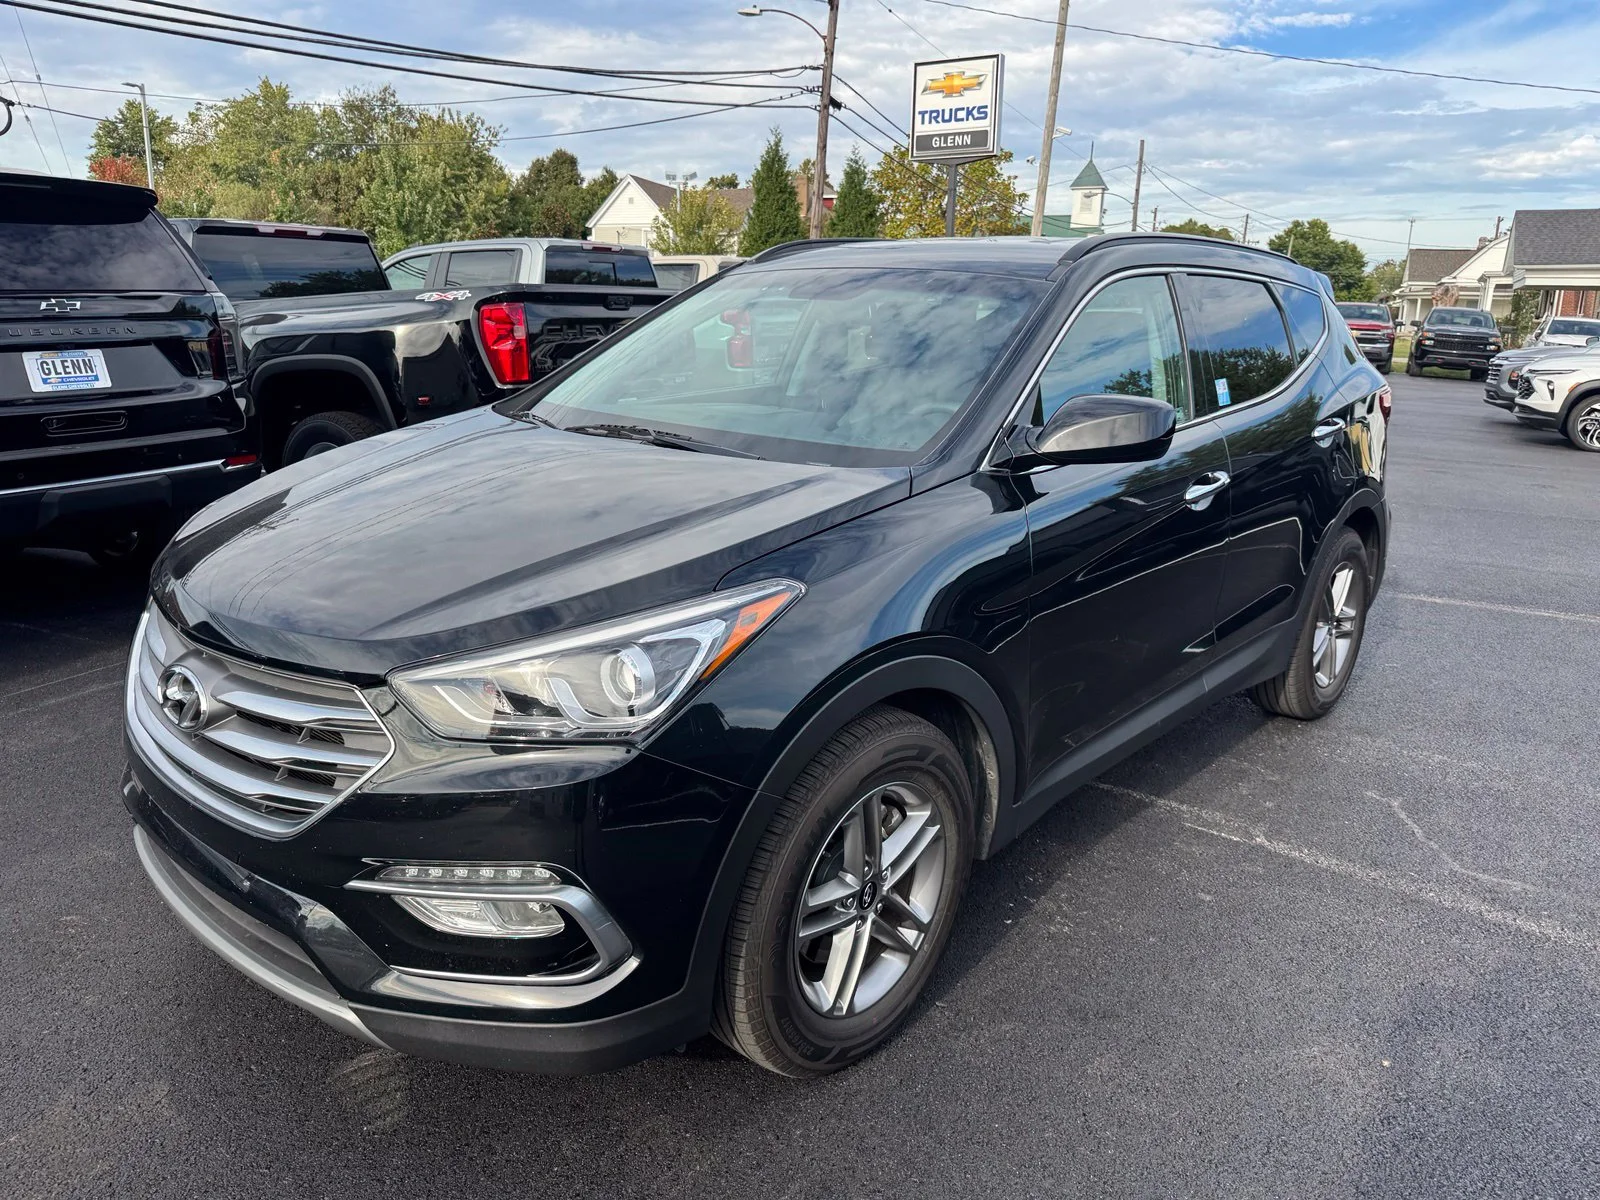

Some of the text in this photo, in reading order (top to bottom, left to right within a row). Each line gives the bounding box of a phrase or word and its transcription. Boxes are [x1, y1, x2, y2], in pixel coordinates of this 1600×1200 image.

[918, 105, 988, 125] TRUCKS
[932, 134, 971, 148] GLENN
[8, 327, 137, 337] UBURBAN
[40, 358, 95, 377] GLENN
